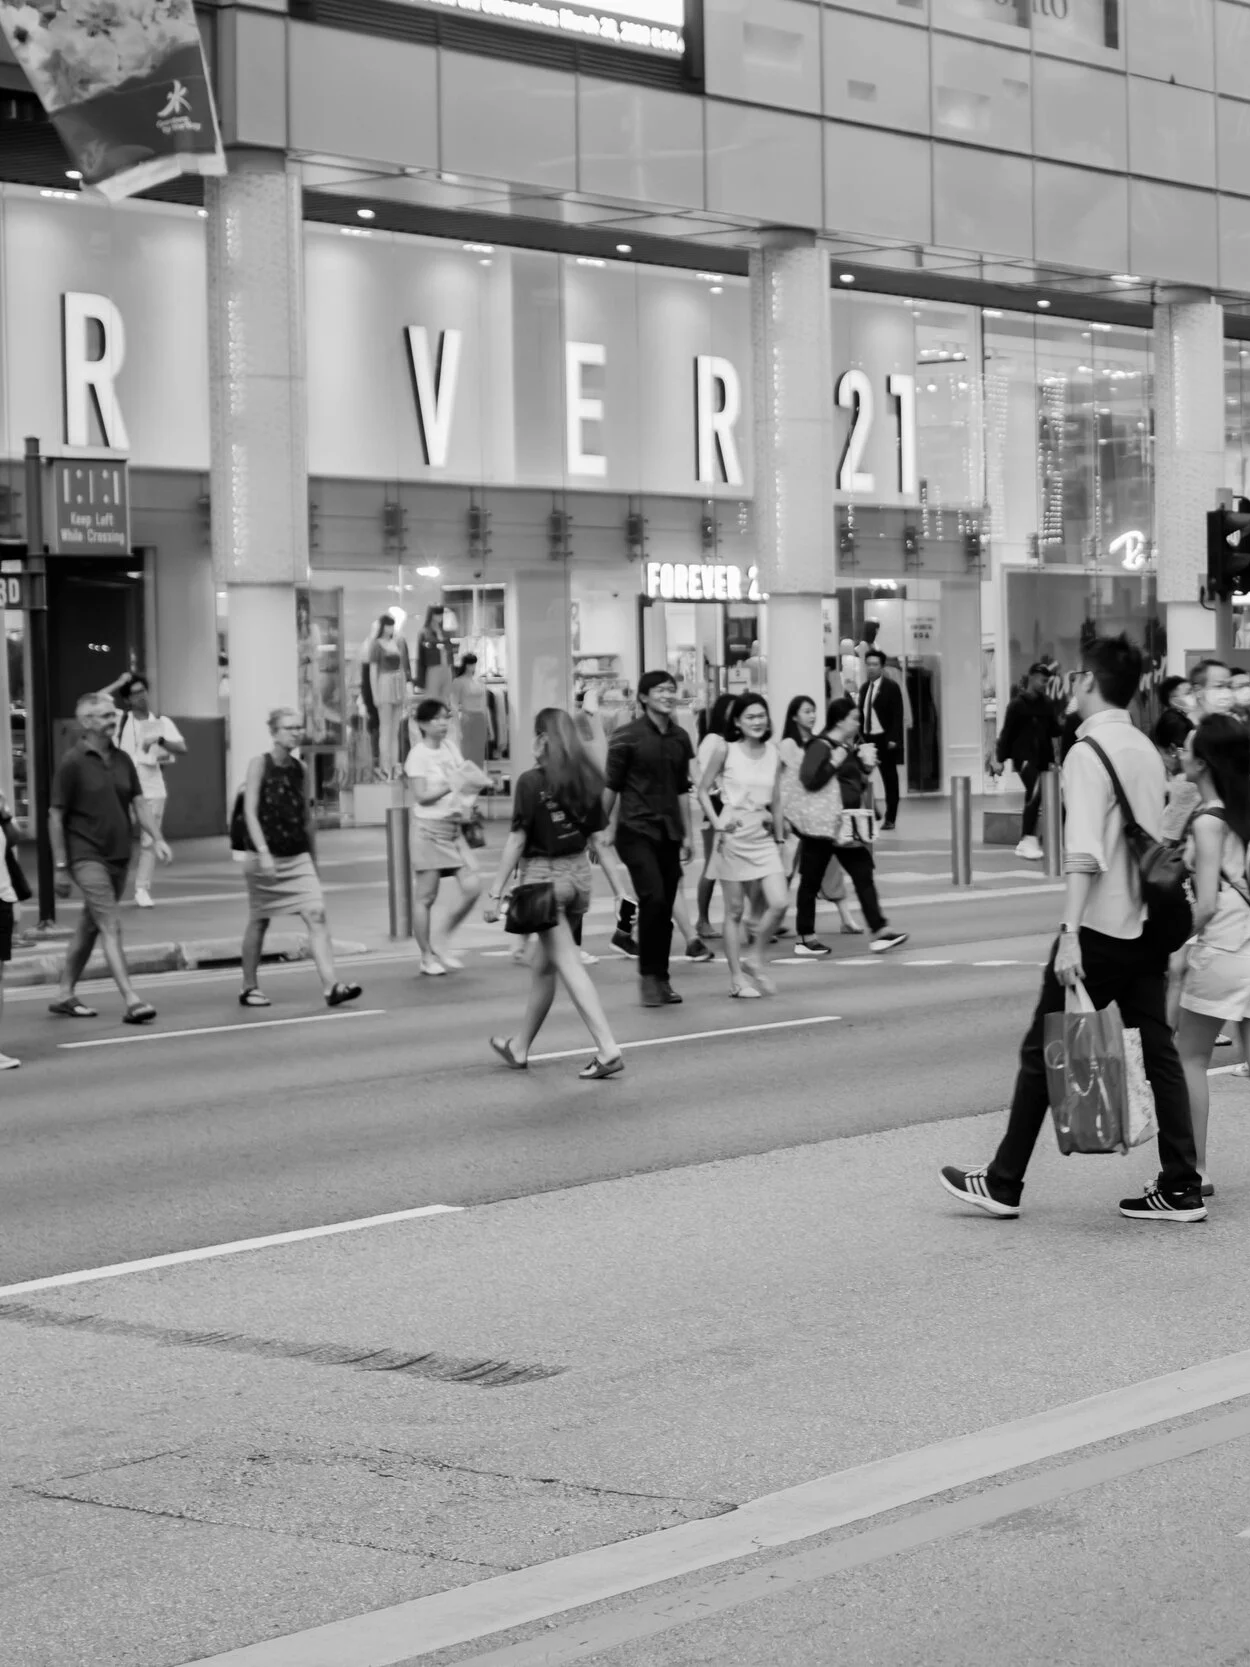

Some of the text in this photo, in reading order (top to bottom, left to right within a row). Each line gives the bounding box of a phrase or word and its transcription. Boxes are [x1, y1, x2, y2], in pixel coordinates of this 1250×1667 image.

[836, 368, 917, 494] 21
[70, 512, 114, 528] Keep Left
[60, 528, 125, 546] While Crossing
[647, 562, 742, 601] FOREVER
